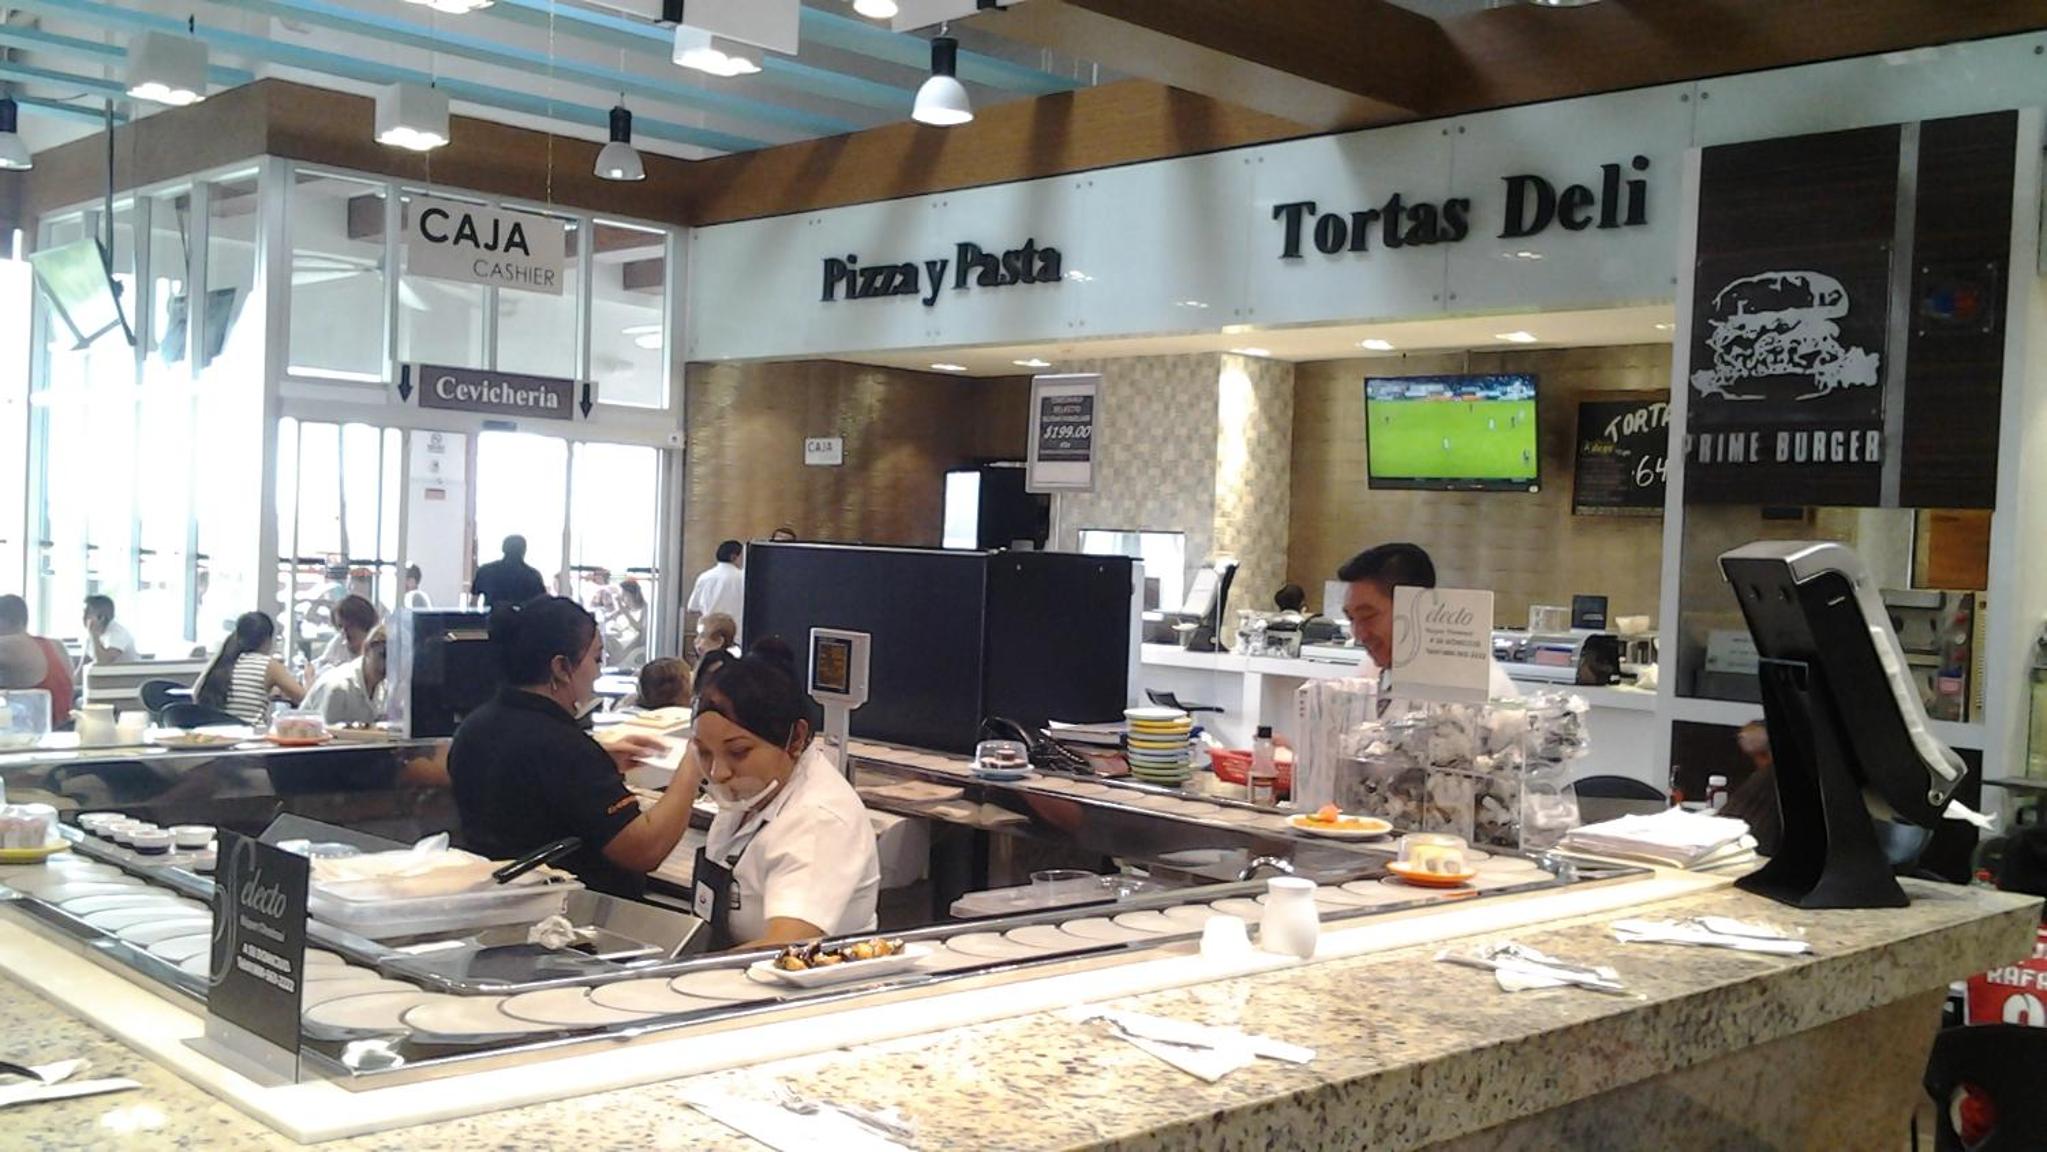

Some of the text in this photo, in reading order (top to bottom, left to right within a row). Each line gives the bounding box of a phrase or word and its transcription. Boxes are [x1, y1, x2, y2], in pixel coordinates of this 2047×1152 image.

[1273, 155, 1650, 258] Tortas Deli
[419, 208, 530, 256] CAJA
[473, 259, 555, 286] CASHIER
[820, 238, 1062, 306] Pizza y Pasta
[436, 376, 559, 409] Cevicheria
[1044, 425, 1092, 439] $199.00
[1775, 430, 1881, 463] BURGER
